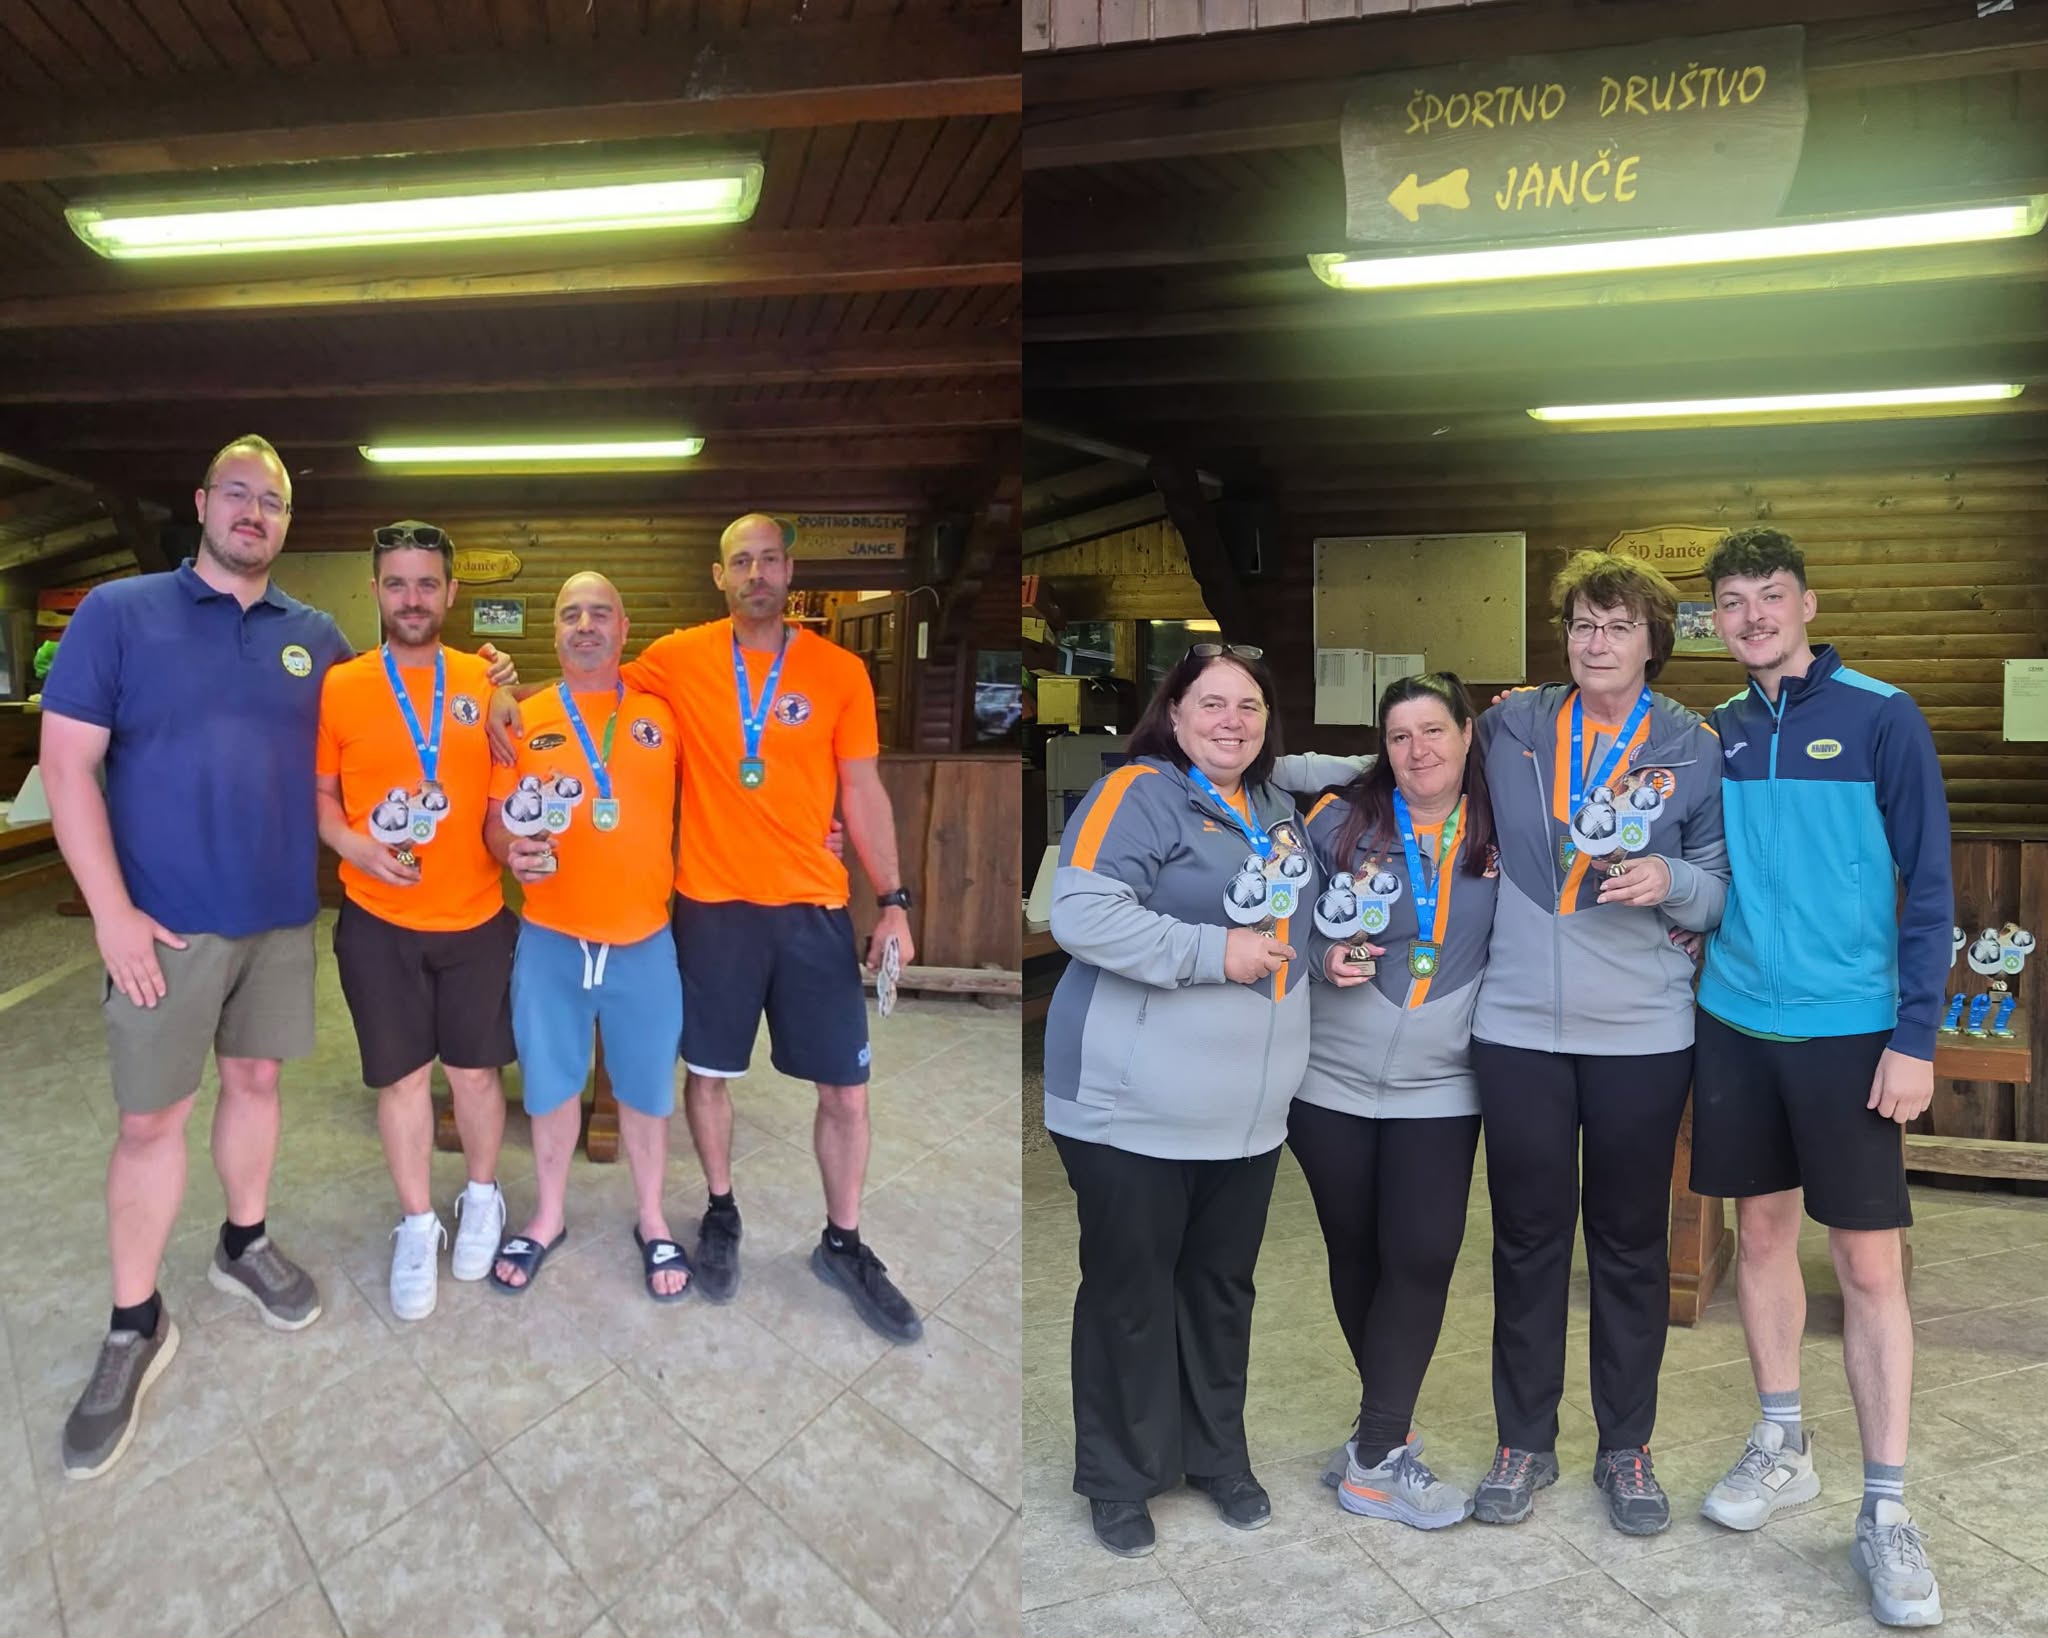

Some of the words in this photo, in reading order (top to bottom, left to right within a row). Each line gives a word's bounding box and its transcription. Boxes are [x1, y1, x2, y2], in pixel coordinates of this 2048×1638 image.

[1404, 83, 1566, 135] ŠPORTNO
[1600, 62, 1767, 117] DRUŠTVO
[1495, 149, 1641, 211] JANČE
[1654, 541, 1706, 559] Janče
